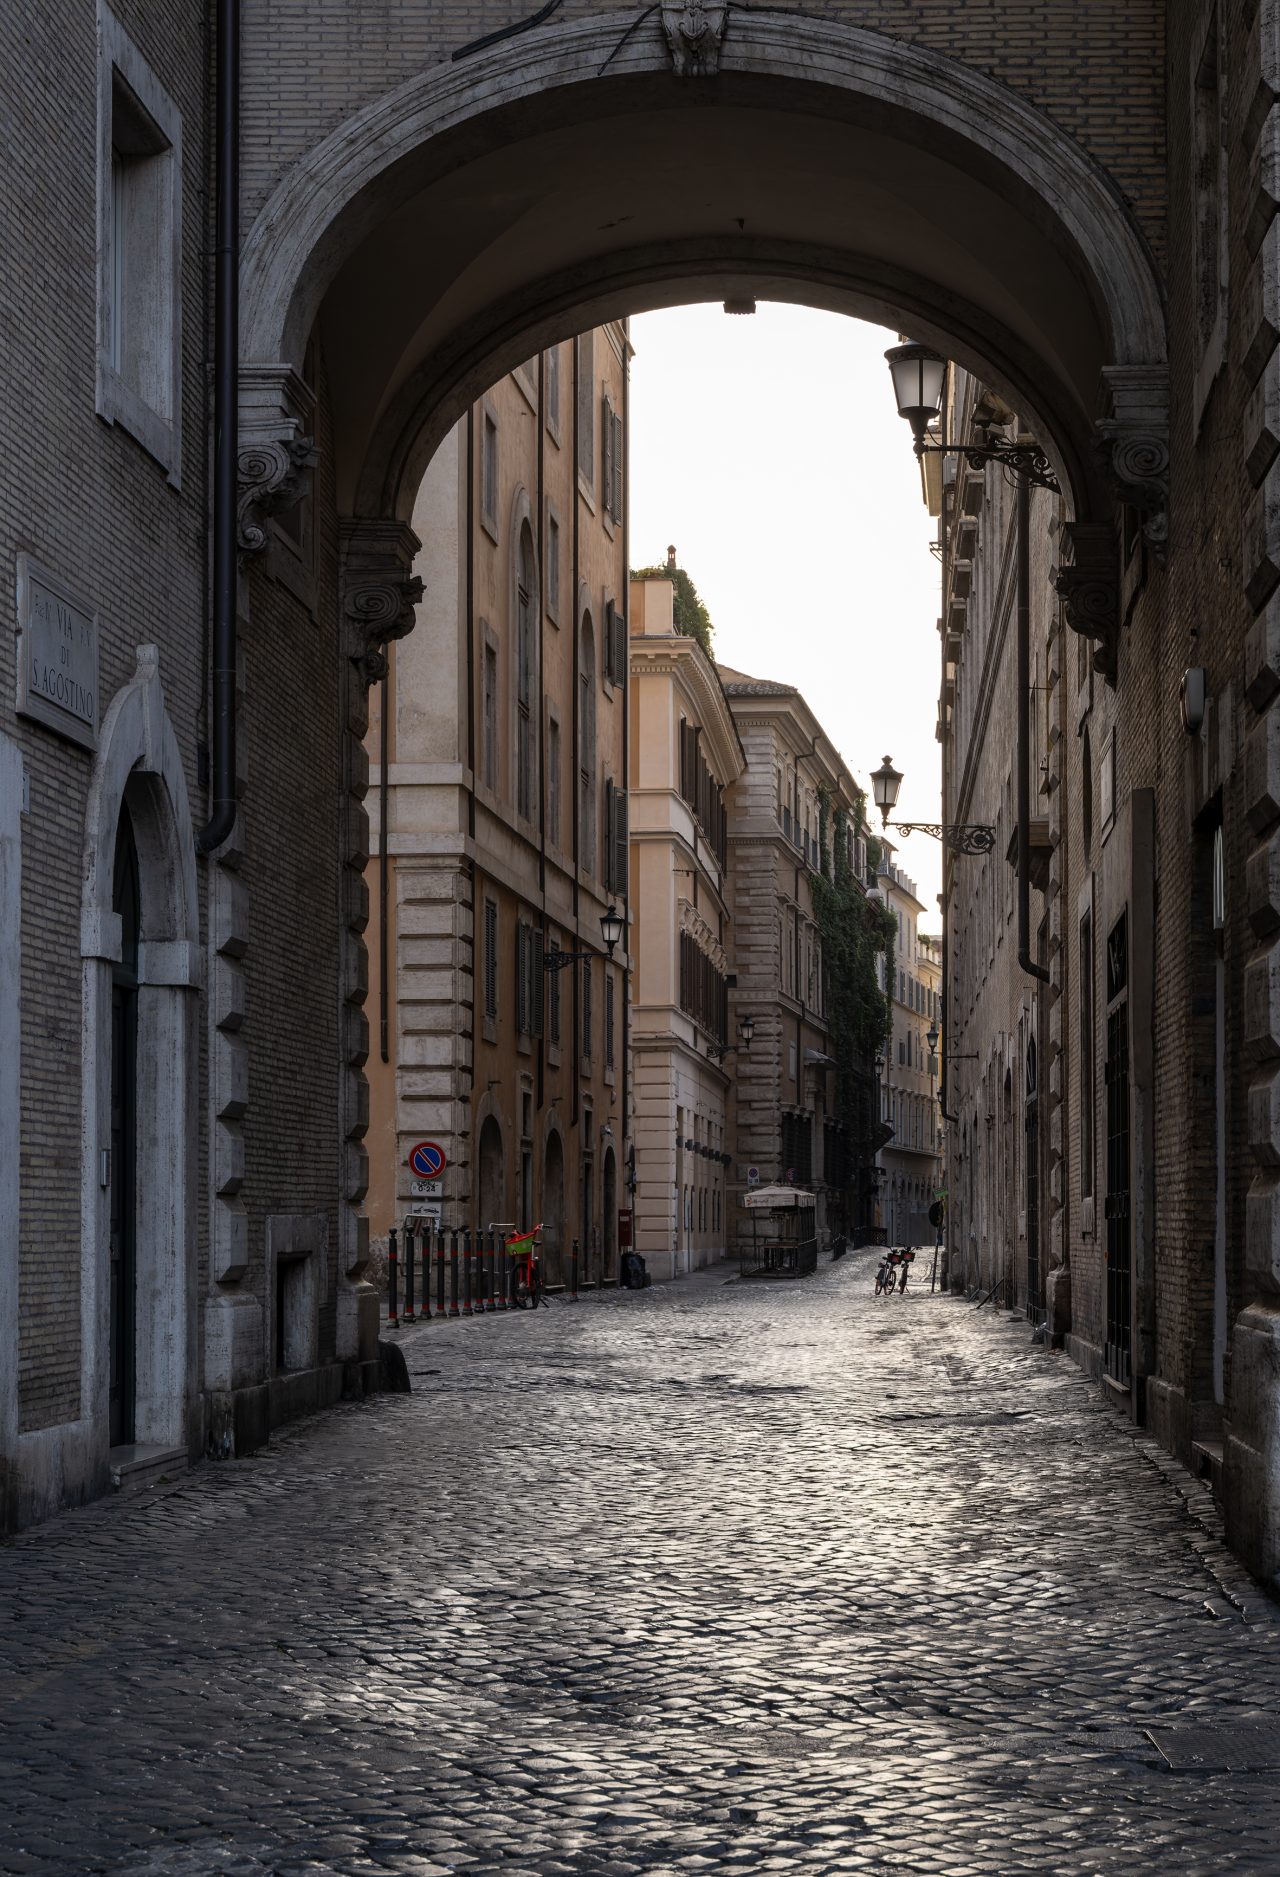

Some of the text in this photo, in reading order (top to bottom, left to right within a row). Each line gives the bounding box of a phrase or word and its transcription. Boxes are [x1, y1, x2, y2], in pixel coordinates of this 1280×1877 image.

[57, 602, 73, 640] VIA
[61, 645, 70, 668] DI
[33, 658, 93, 718] S. AGOSTINO
